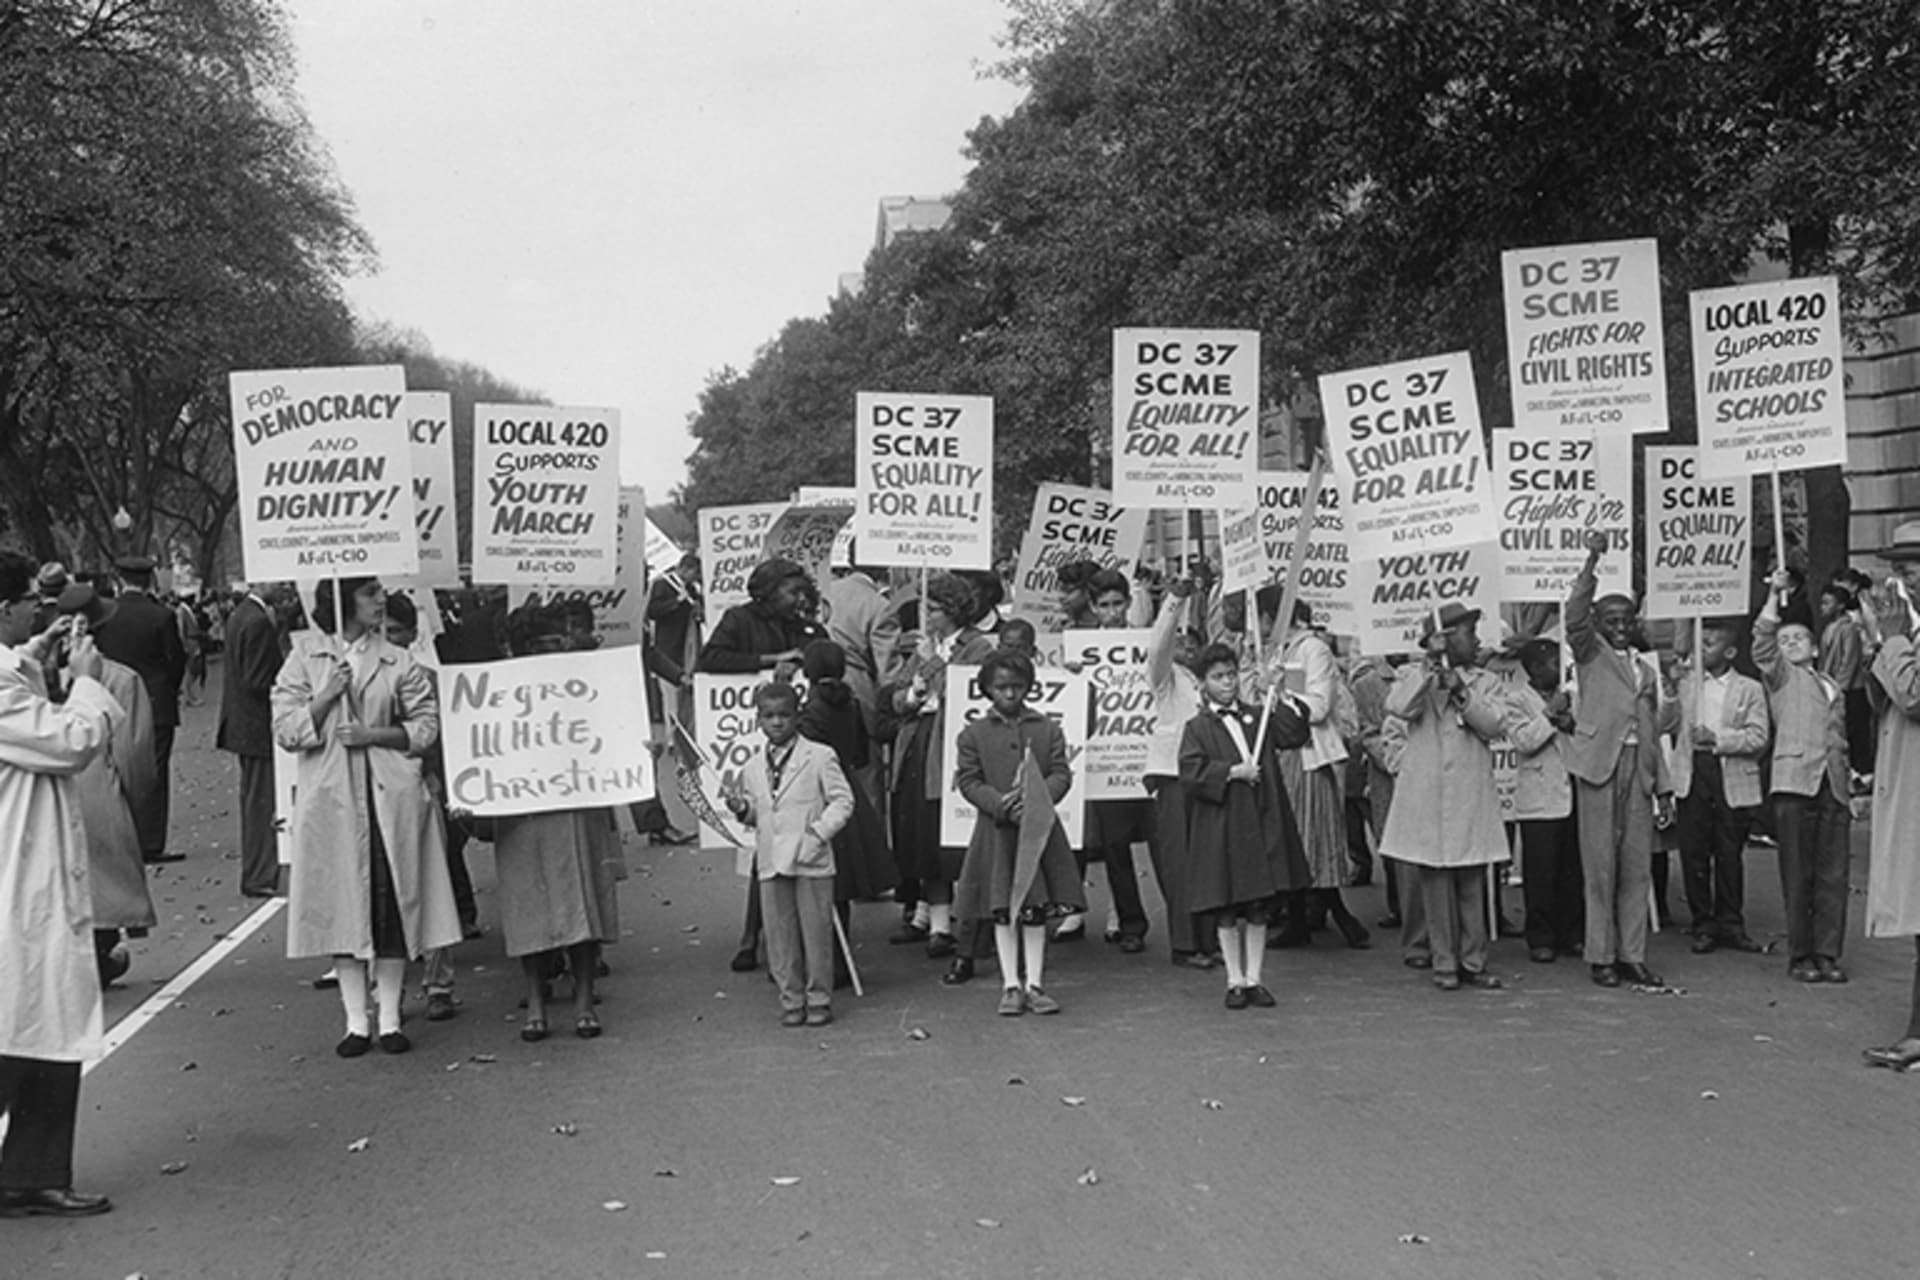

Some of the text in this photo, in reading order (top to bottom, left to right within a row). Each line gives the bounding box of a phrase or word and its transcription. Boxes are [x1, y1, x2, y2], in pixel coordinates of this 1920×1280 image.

[1520, 256, 1621, 288] DC 37
[1523, 290, 1620, 320] SCME
[1706, 293, 1826, 331] LOCAL 420
[1138, 342, 1238, 366] DC 37
[1527, 321, 1645, 359] FIGHTS FOR
[1715, 327, 1821, 366] SUPPORTS
[1521, 352, 1653, 385] CIVIL RIGHTS
[1708, 357, 1833, 393] INTEGRATED
[246, 385, 290, 411] FOR
[1135, 372, 1232, 396] SCME
[1346, 368, 1448, 407] DC 37
[242, 394, 402, 446] DEMOCRACY
[873, 405, 962, 429] DC 37
[1126, 400, 1250, 432] EQUALITY
[1716, 389, 1827, 423] SCHOOLS
[488, 419, 609, 447] LOCAL 420
[1350, 401, 1456, 440] SCME
[307, 437, 358, 452] AND
[872, 434, 958, 458] SCME
[1124, 431, 1250, 459] FOR ALL!
[1345, 429, 1471, 478] EQUALITY
[1510, 441, 1593, 461] DC 37
[264, 456, 386, 487] HUMAN
[495, 451, 599, 478] SUPPORTS
[871, 462, 983, 490] EQUALITY
[1661, 458, 1695, 479] DC
[488, 476, 588, 507] YOUTH
[1352, 456, 1479, 504] FOR ALL!
[1509, 470, 1596, 491] SCME
[257, 485, 401, 521] DIGNITY!
[868, 492, 981, 523] FOR ALL!
[1048, 496, 1086, 517] DC
[1317, 487, 1339, 509] 42
[1504, 493, 1585, 529] Fights
[1662, 486, 1735, 510] SCME
[491, 505, 594, 535] MARCH
[711, 513, 771, 532] DC 37
[1042, 520, 1117, 547] SCME
[1660, 514, 1746, 542] EQUALITY
[712, 534, 761, 553] SCM
[1501, 528, 1629, 551] CIVIL RIGTS
[1378, 550, 1470, 579] YOUTH
[1656, 540, 1746, 570] FOR ALL!
[710, 577, 745, 593] FOR
[1372, 576, 1480, 604] MARCH
[1081, 646, 1148, 665] SCM
[711, 687, 757, 711] LOC
